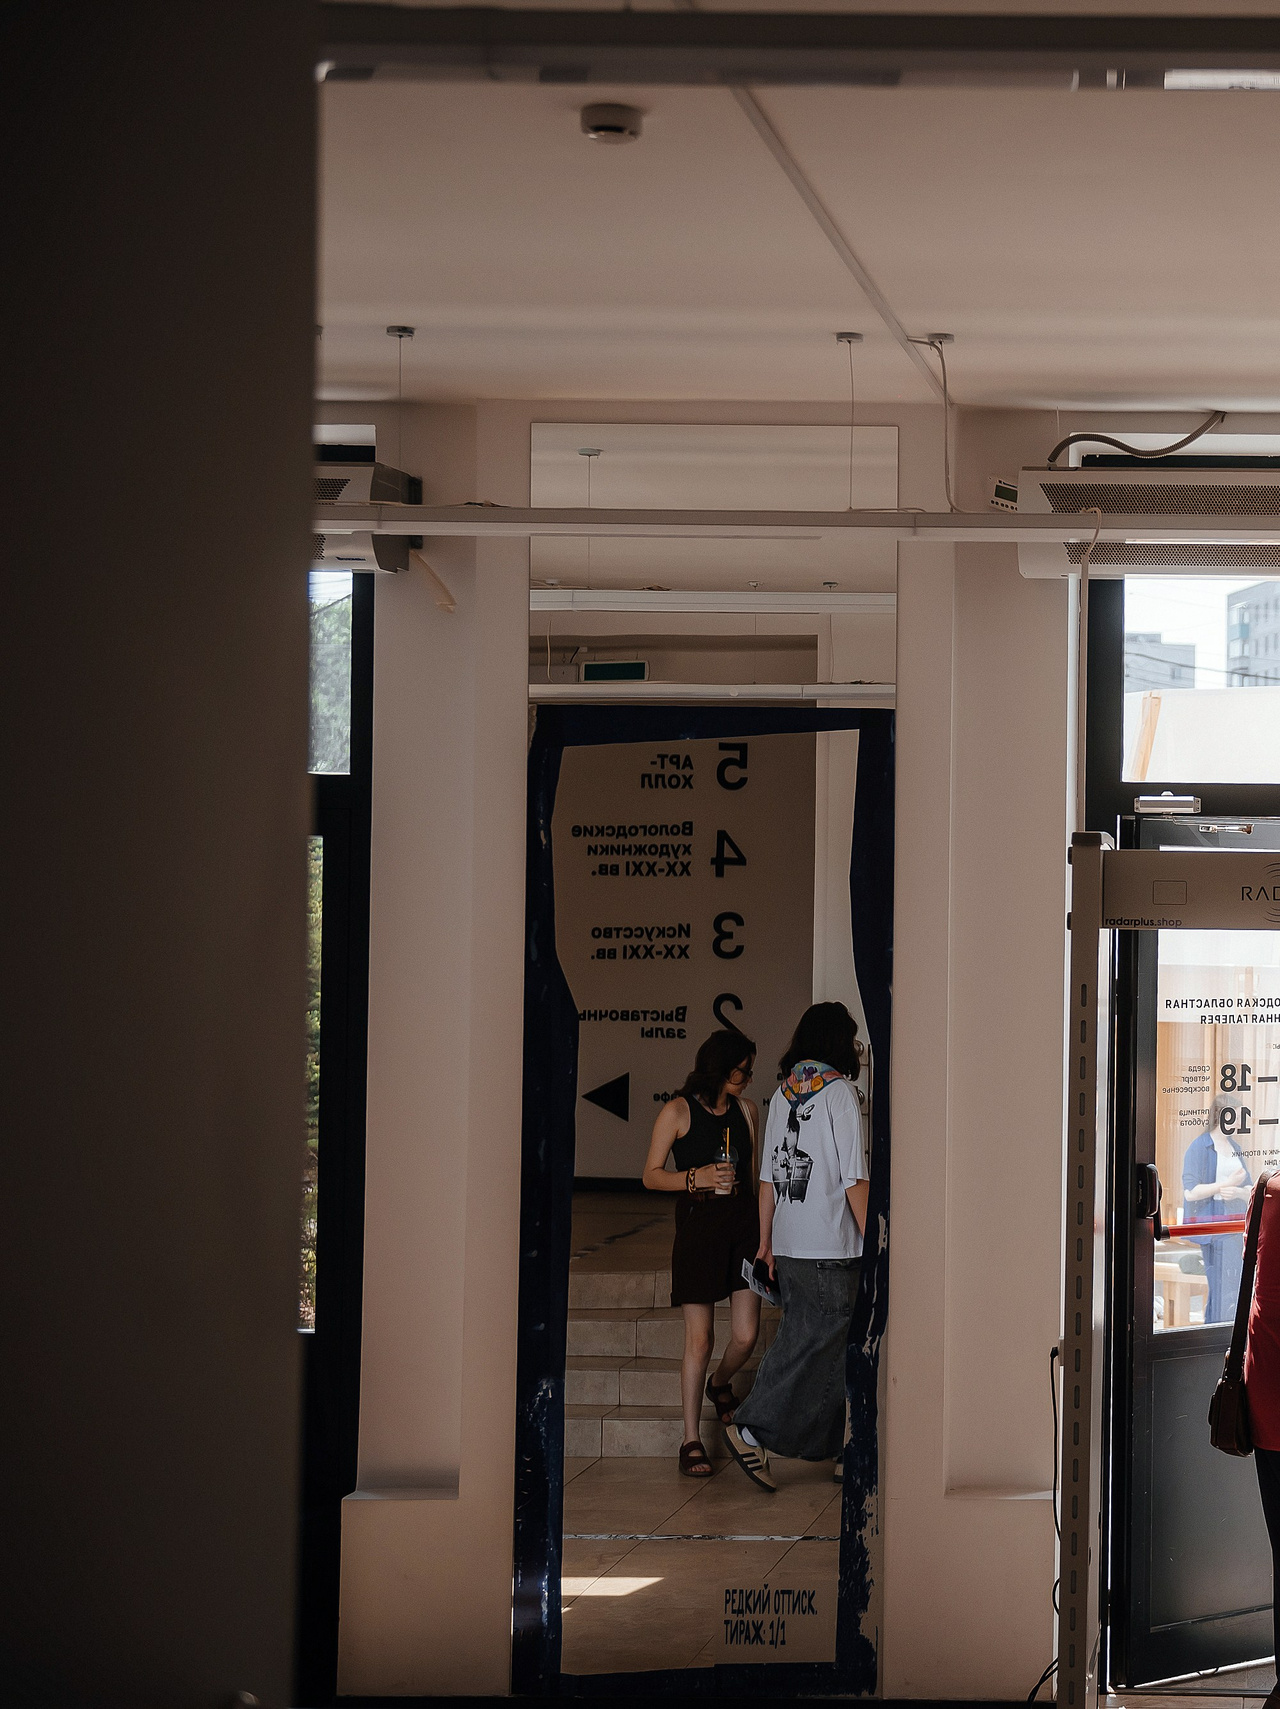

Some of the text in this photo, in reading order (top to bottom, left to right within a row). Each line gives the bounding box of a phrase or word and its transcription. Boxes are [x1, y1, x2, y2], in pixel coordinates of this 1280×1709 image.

[1105, 917, 1182, 928] radarplus.shop
[725, 1583, 818, 1617] РЕДКИЙ ОТТИСК.
[724, 1616, 786, 1649] ТИРАЖ: 1/1
